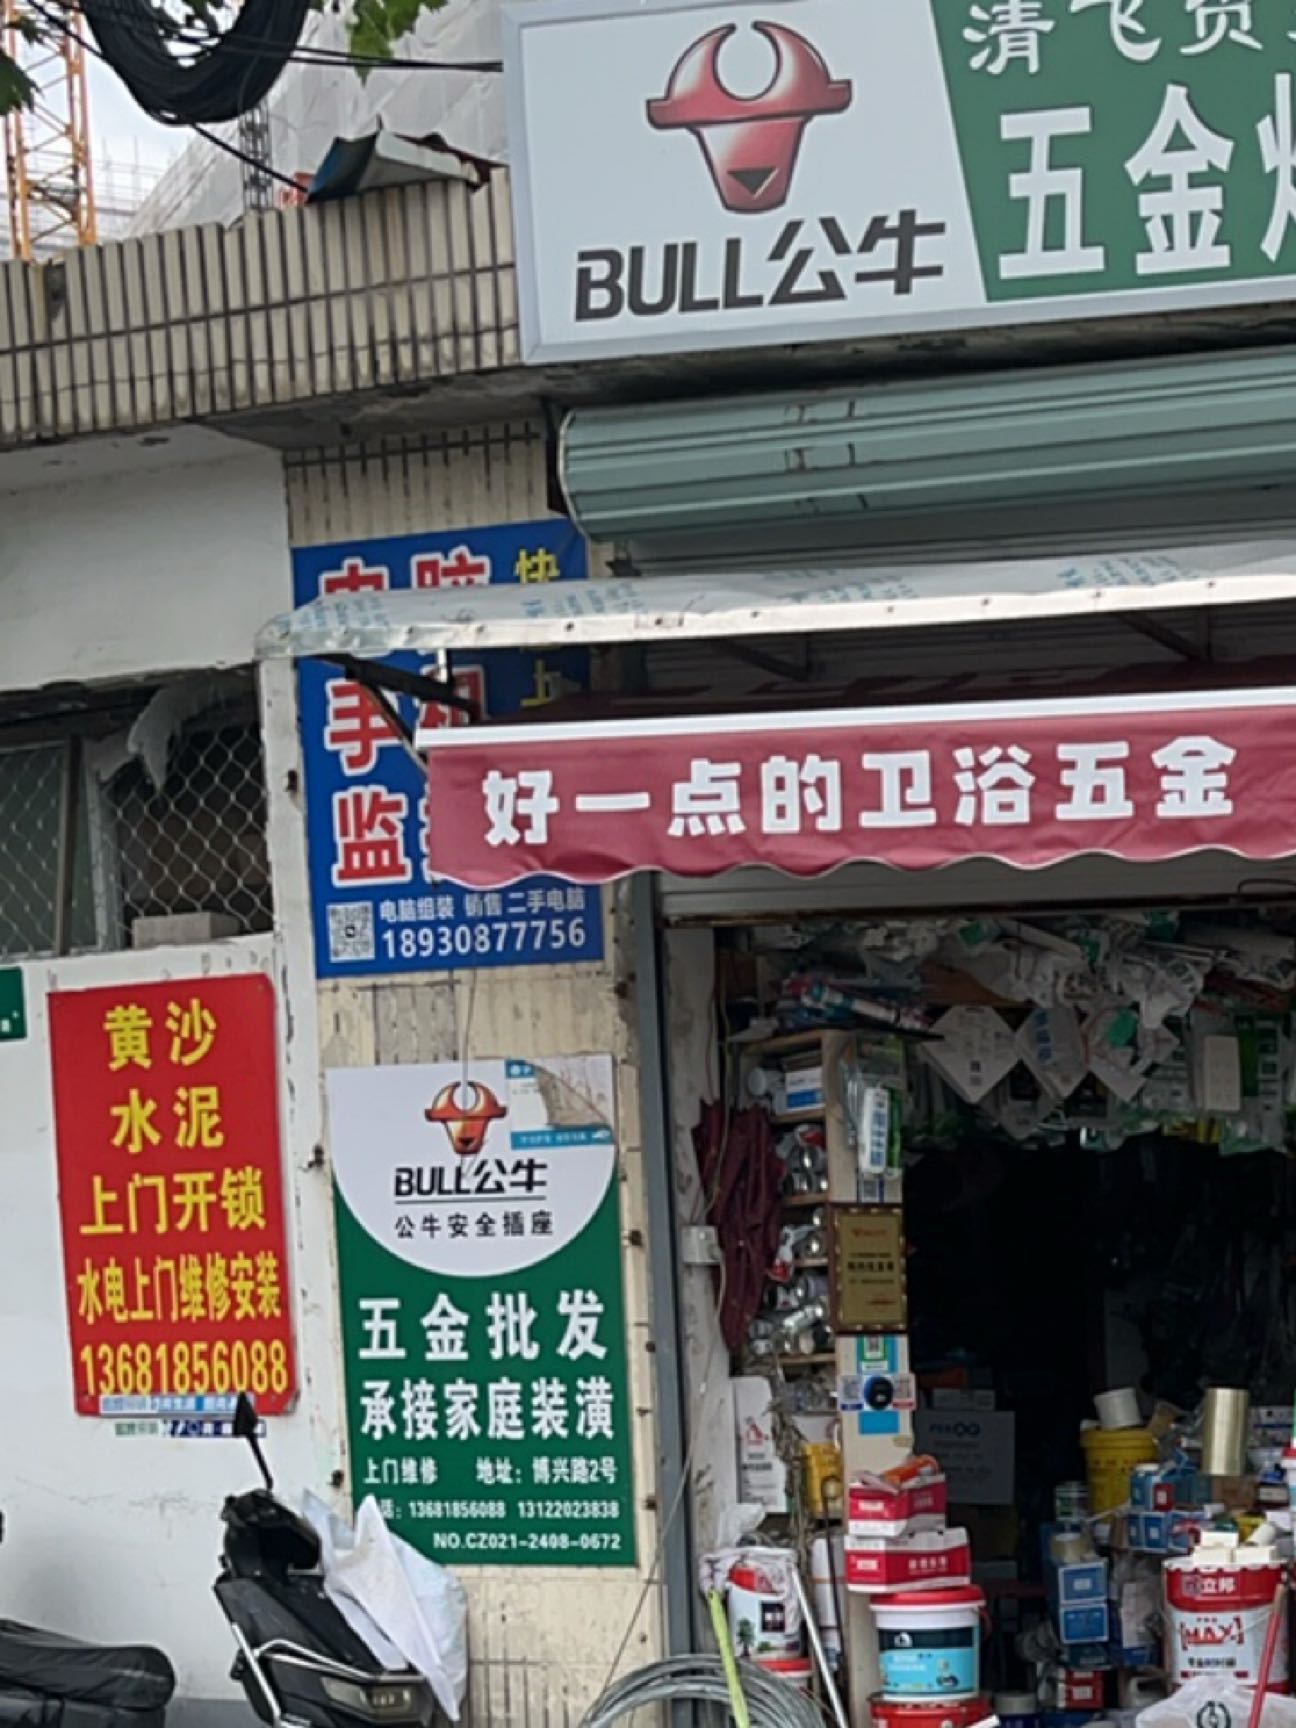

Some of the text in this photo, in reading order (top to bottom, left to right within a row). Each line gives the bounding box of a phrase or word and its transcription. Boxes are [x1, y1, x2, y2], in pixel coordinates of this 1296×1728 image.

[574, 208, 946, 322] BULL公牛
[480, 736, 1237, 847] 好一点的卫浴五金
[381, 916, 586, 960] 18930877756
[103, 998, 217, 1071] 黄沙
[109, 1087, 224, 1153] 水泥
[80, 1166, 266, 1235] 上门开锁
[394, 1158, 547, 1198] BULL公牛
[395, 1209, 554, 1238] 公牛安全插座
[77, 1250, 281, 1324] 水电上门维修安装
[359, 1289, 607, 1361] 五金批发
[80, 1339, 288, 1397] 13681856088
[359, 1377, 615, 1441] 承接家庭装潢
[363, 1456, 438, 1485] 上门维修
[516, 1500, 619, 1520] 13122023838
